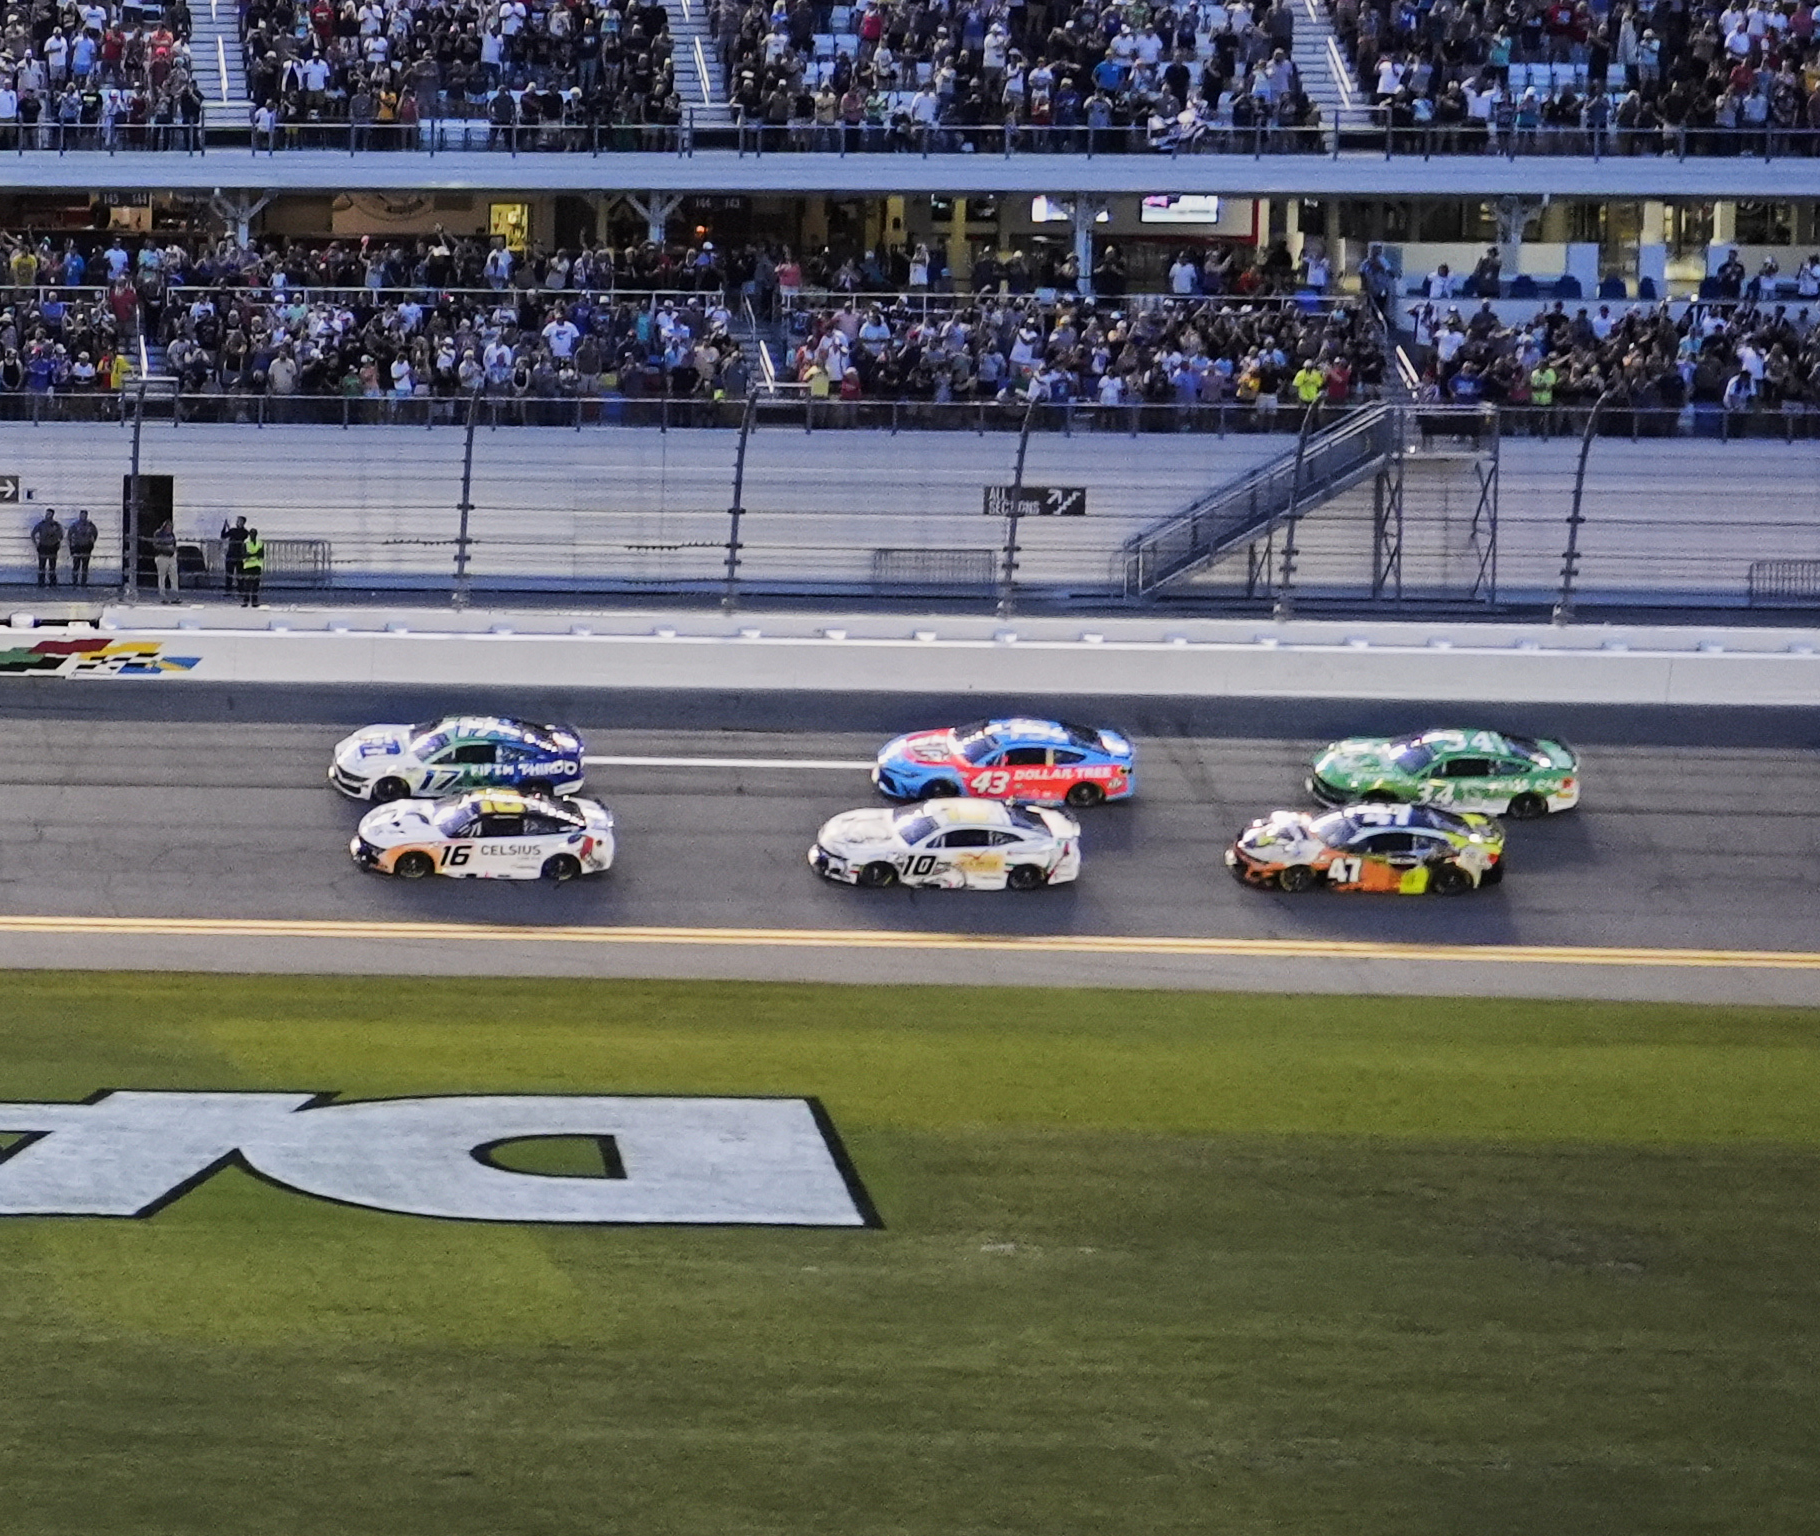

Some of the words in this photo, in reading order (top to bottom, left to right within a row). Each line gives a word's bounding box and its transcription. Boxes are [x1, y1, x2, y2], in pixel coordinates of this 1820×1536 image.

[420, 769, 465, 791] 17
[470, 763, 516, 777] FIFTH
[1013, 767, 1073, 781] DOLLAR
[1075, 765, 1111, 779] TREE
[970, 770, 1011, 794] 43
[439, 844, 473, 866] 16
[480, 844, 542, 856] CELSIUS
[903, 855, 938, 876] 10
[1327, 857, 1362, 883] 47
